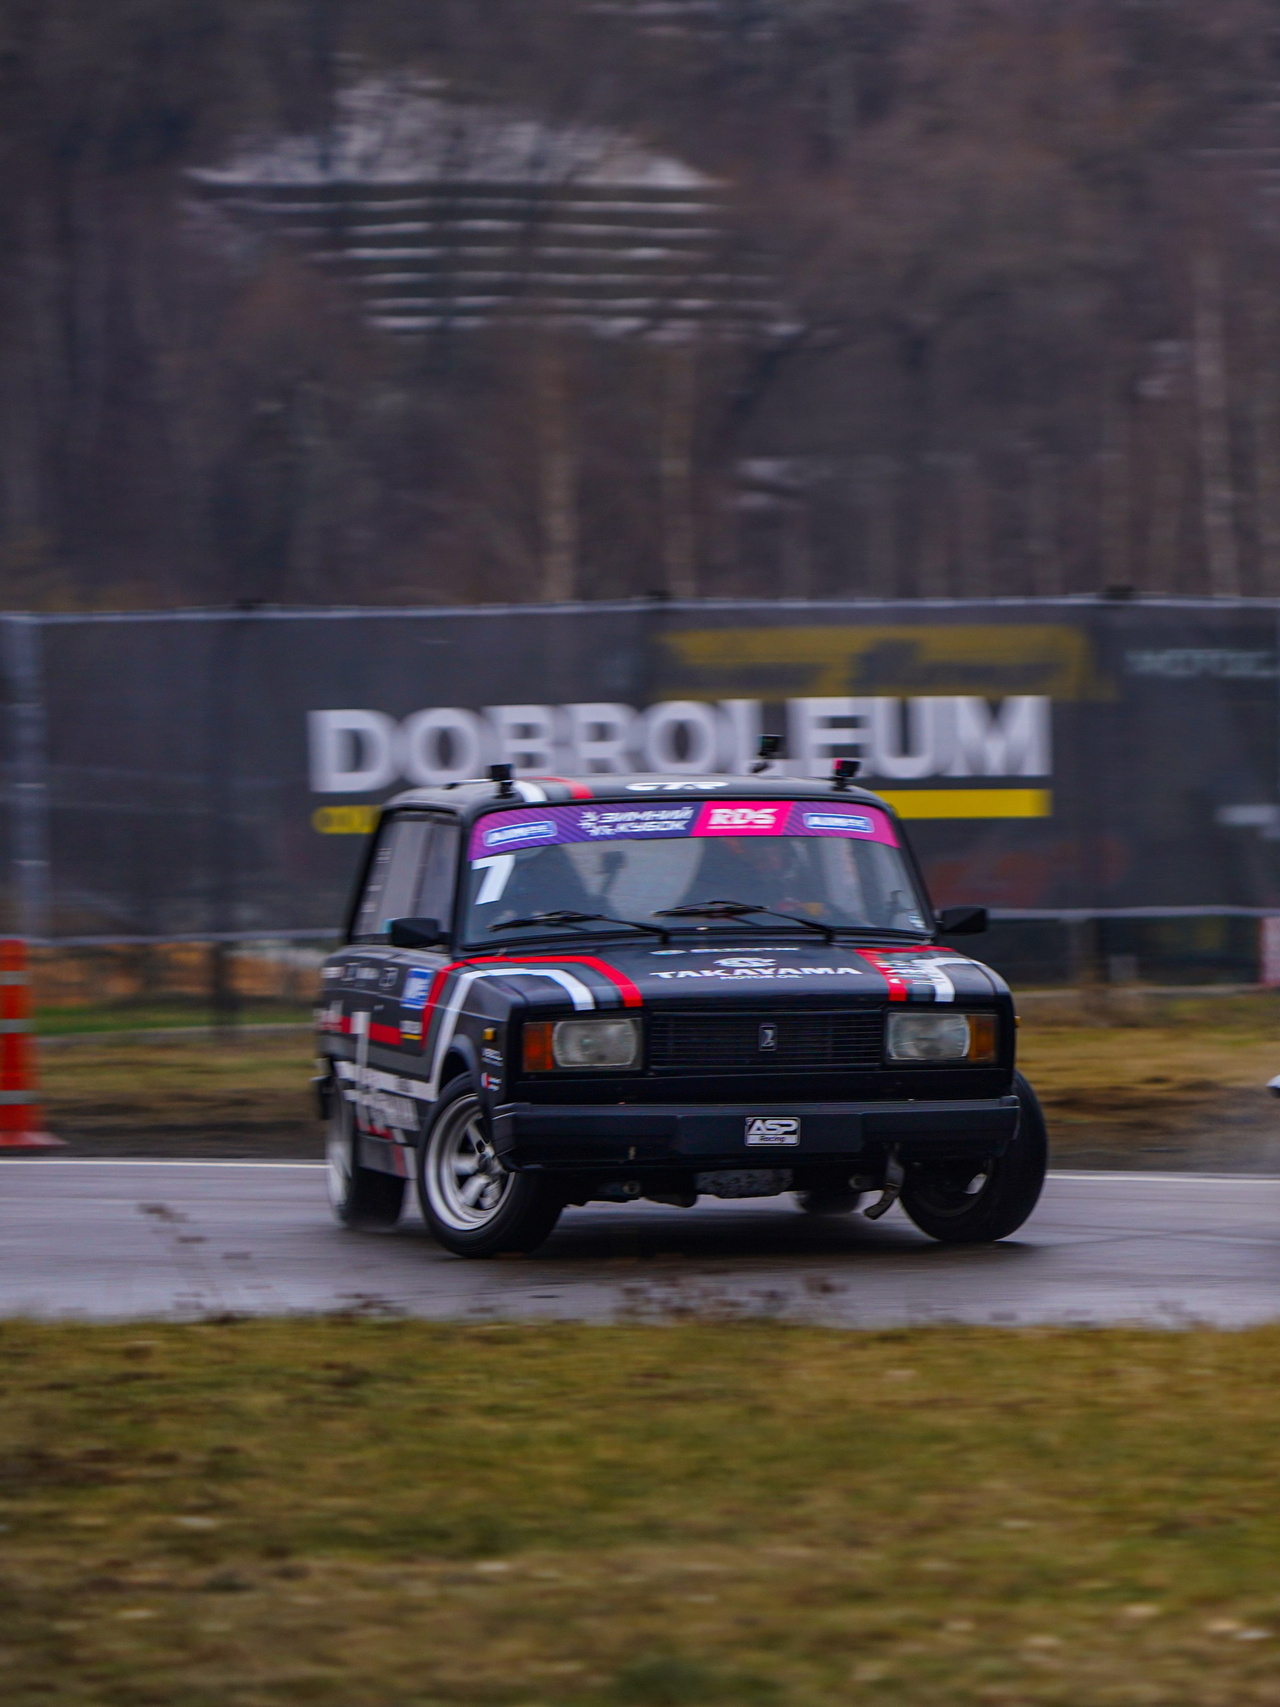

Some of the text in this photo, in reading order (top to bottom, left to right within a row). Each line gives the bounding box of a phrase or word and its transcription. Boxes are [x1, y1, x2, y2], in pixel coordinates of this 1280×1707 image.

[308, 696, 1052, 792] DOBROLEUM
[708, 808, 779, 825] RDS
[649, 967, 863, 979] TAKAYAMA
[747, 1119, 799, 1135] ASP
